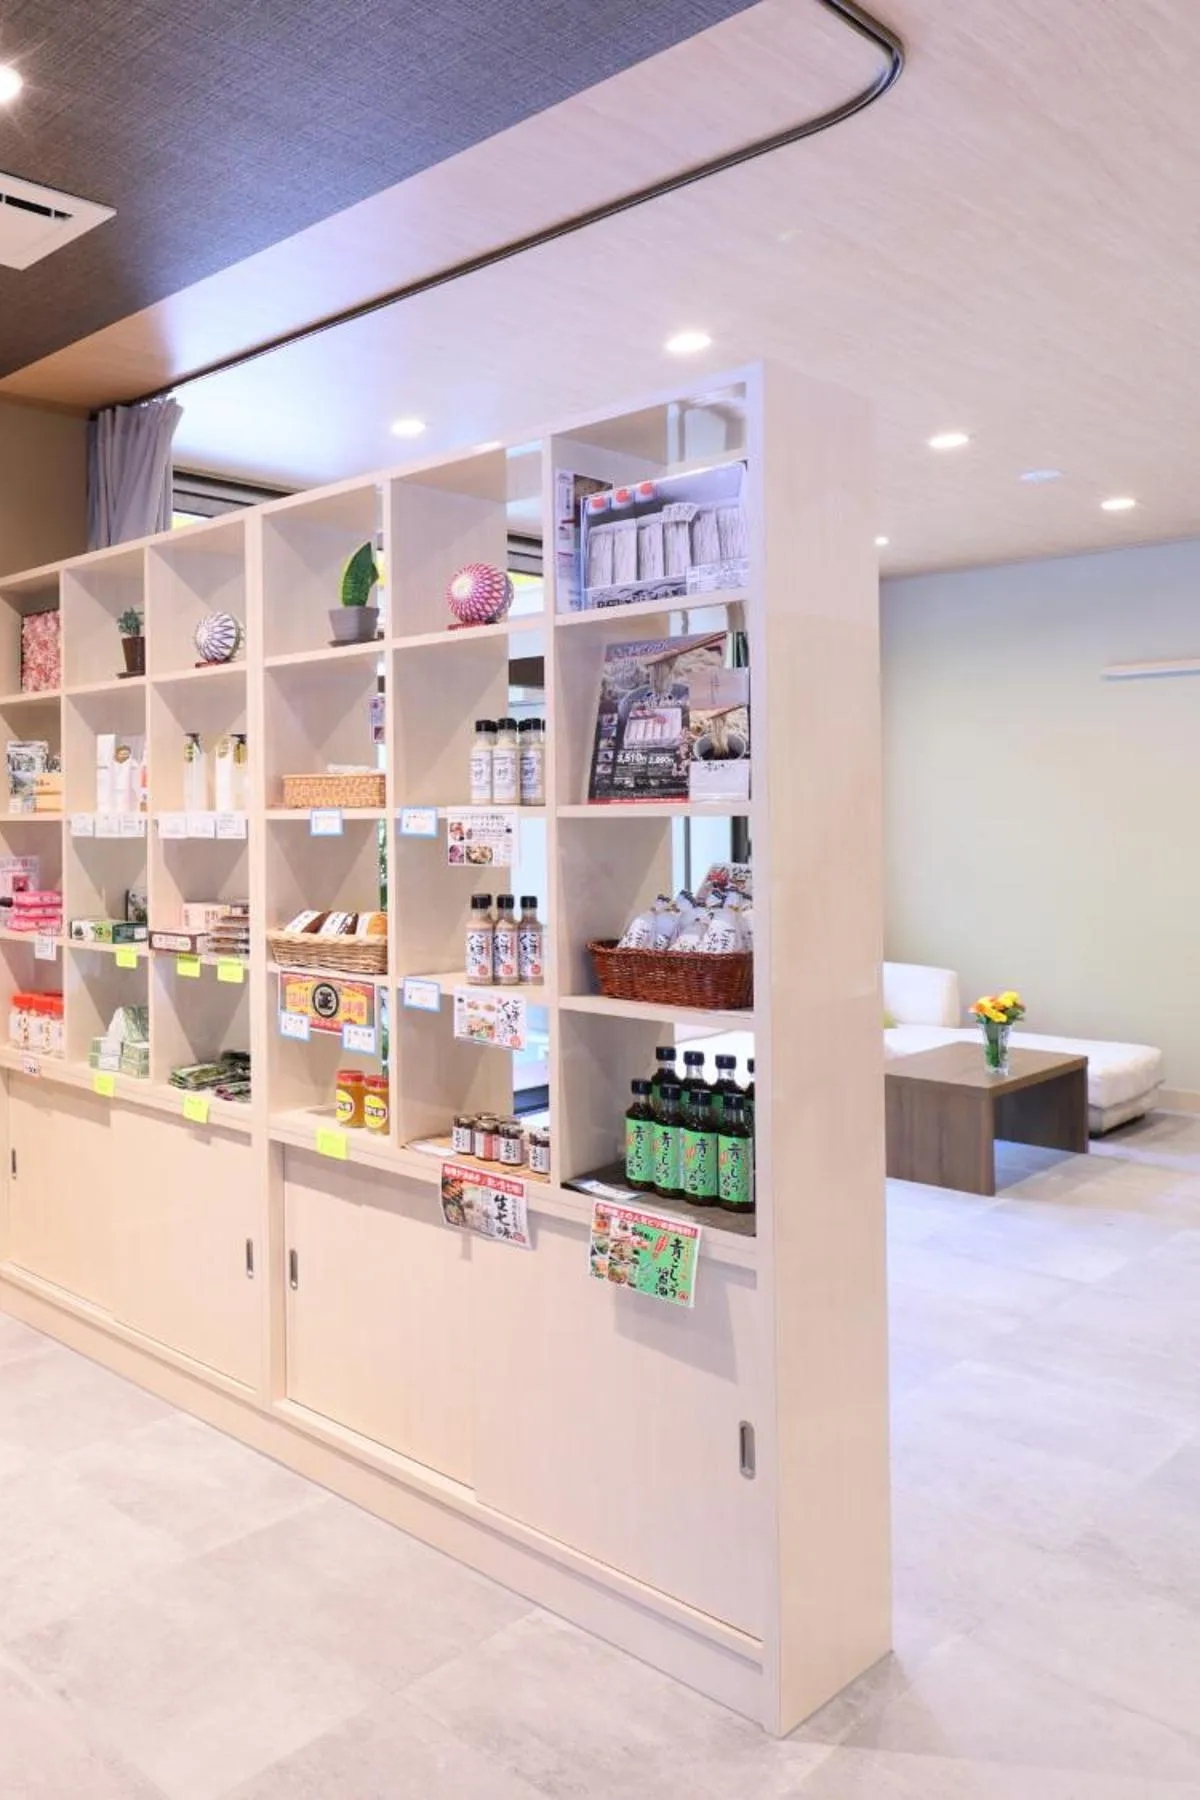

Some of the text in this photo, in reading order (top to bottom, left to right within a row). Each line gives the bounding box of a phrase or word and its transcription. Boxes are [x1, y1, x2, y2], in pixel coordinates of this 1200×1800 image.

[670, 1237, 685, 1298] 青こしょう
